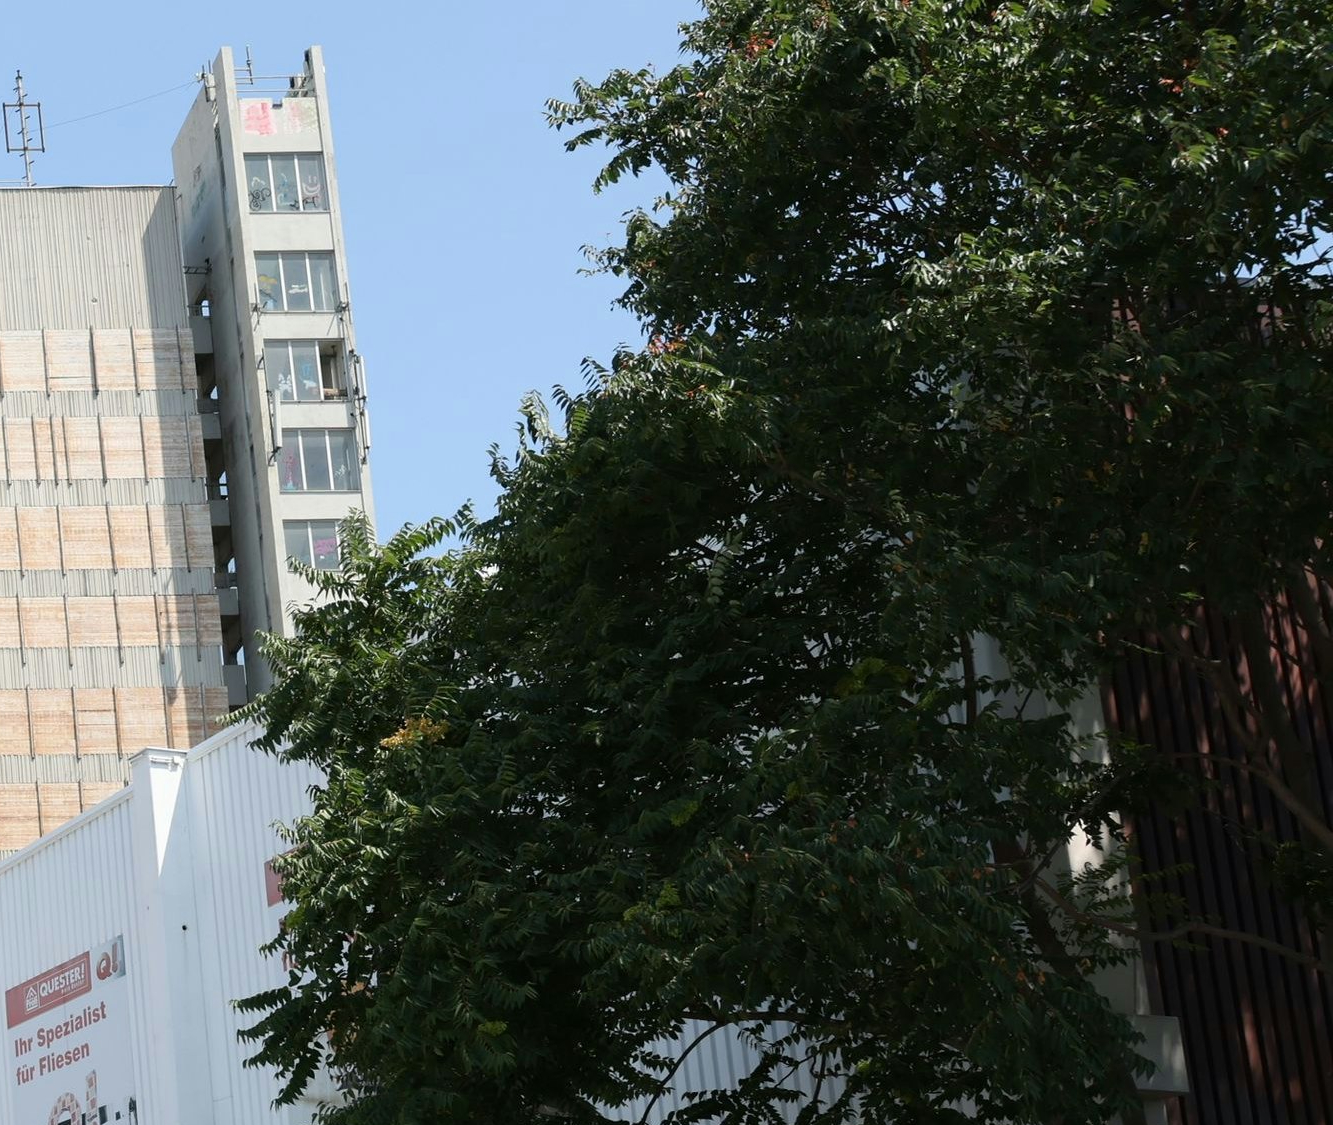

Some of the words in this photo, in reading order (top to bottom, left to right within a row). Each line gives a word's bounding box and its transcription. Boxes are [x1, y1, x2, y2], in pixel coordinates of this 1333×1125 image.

[39, 962, 85, 997] QUESTER!
[14, 1037, 33, 1058] Ihr
[36, 1001, 107, 1049] Spezialist
[16, 1064, 35, 1086] für
[39, 1042, 90, 1076] Fliesen
